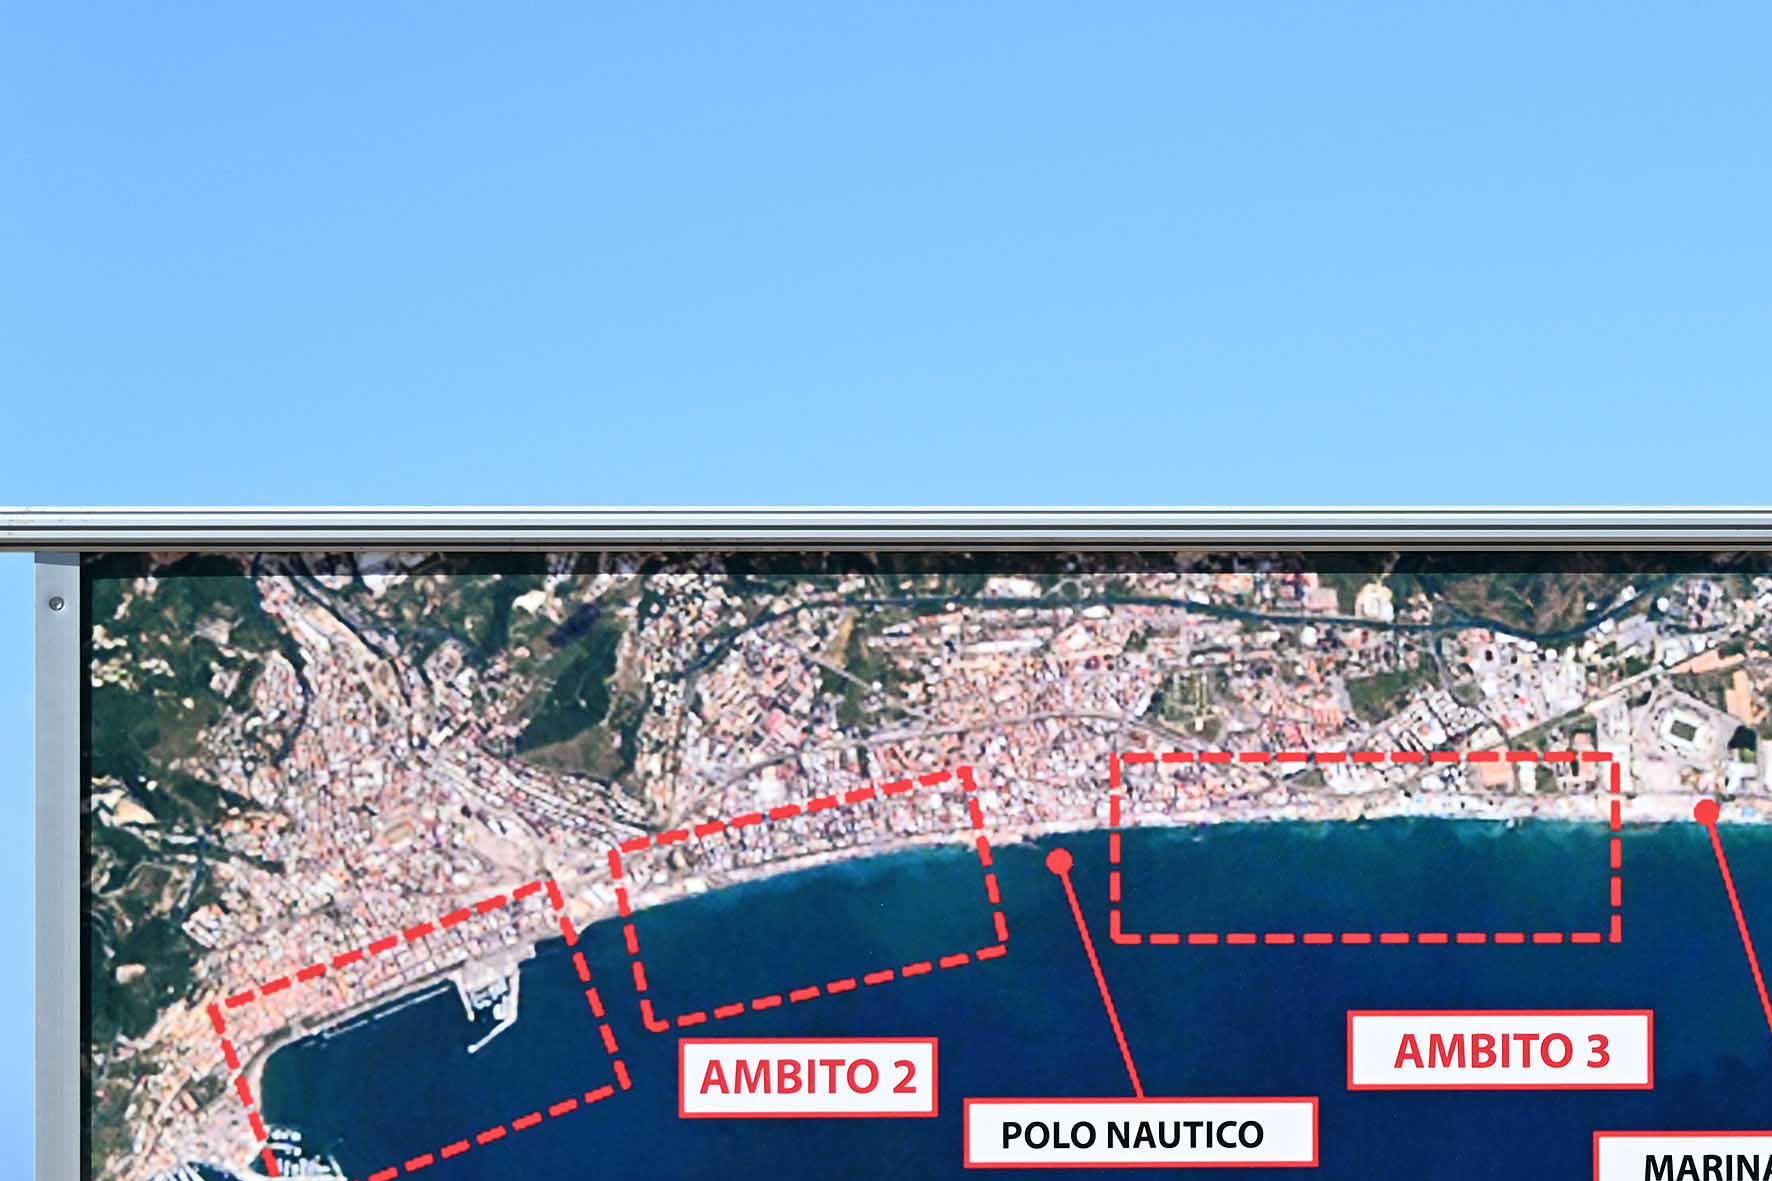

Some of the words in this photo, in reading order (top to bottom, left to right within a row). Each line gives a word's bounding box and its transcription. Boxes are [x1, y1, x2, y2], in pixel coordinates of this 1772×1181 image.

[1393, 1032, 1574, 1069] AMBITO
[1586, 1032, 1610, 1069] 3
[699, 1058, 880, 1095] AMBITO
[892, 1058, 917, 1095] 2
[1002, 1120, 1097, 1150] POLO
[1107, 1120, 1264, 1150] NAUTICO
